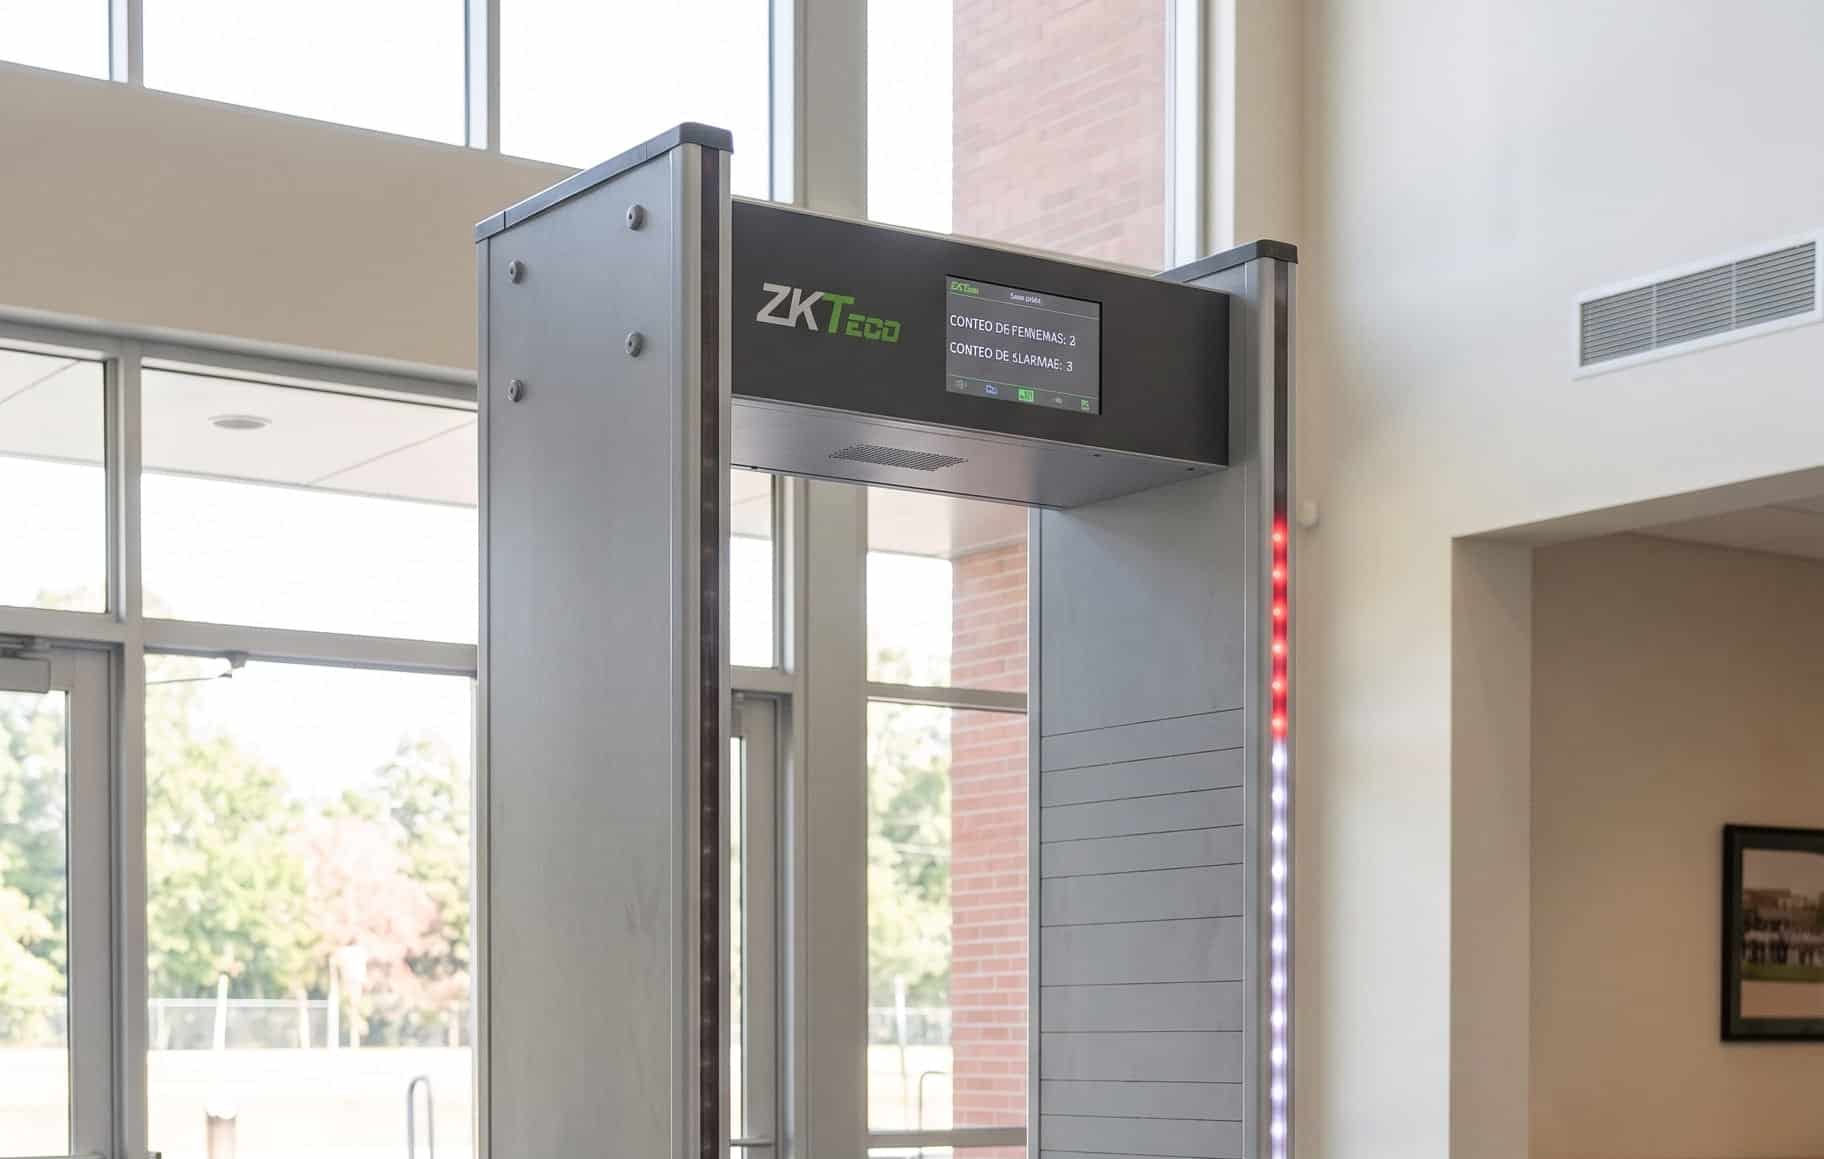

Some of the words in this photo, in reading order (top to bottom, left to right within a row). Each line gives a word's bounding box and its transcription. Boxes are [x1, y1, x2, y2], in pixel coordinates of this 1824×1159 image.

[949, 314, 993, 332] CONTEO
[1069, 335, 1077, 347] 2
[949, 341, 993, 359] CONTEO
[995, 349, 1010, 362] DE
[1066, 361, 1074, 373] 3
